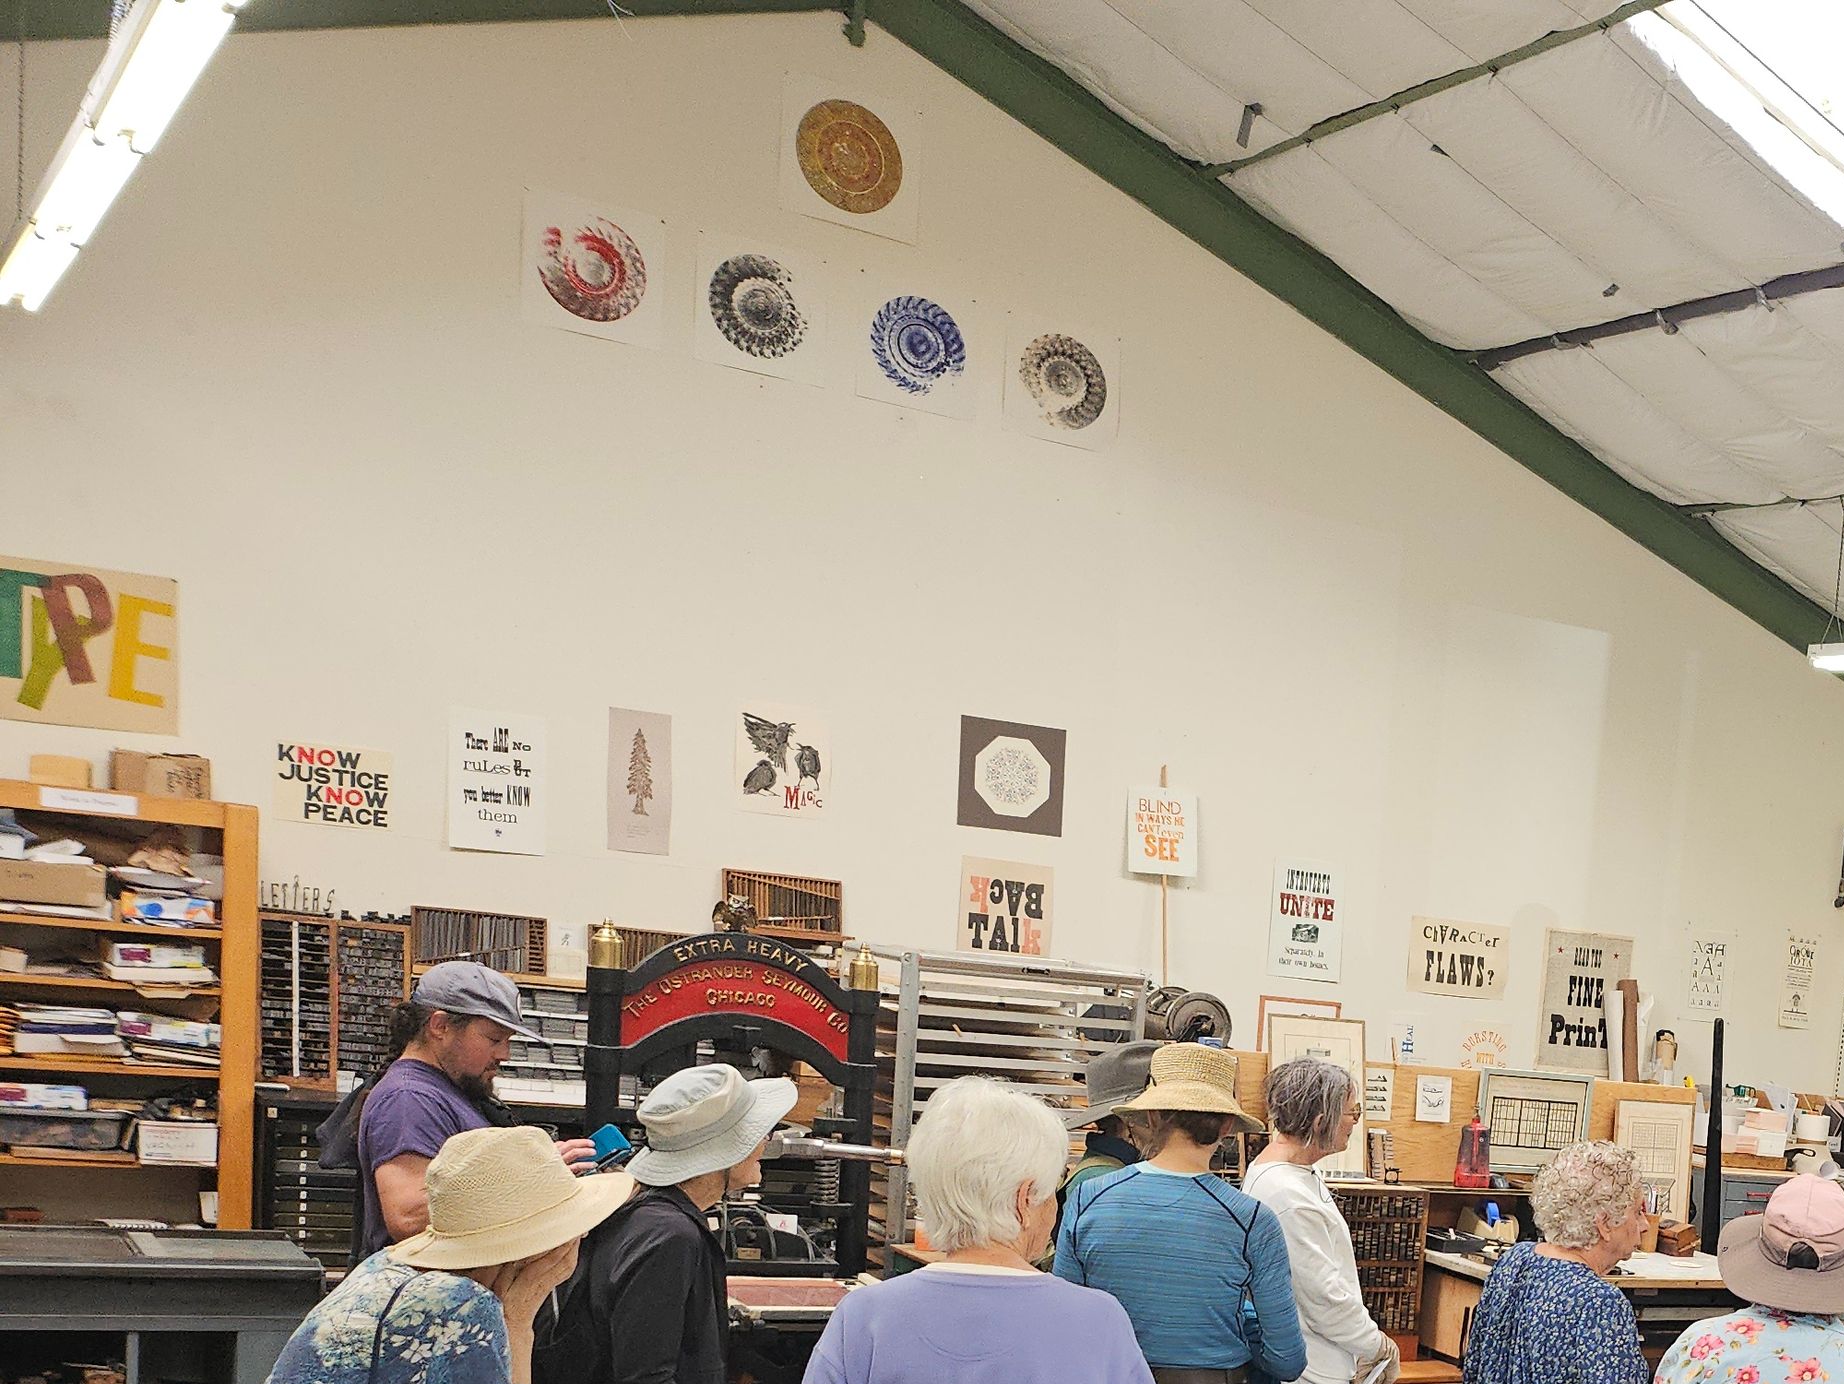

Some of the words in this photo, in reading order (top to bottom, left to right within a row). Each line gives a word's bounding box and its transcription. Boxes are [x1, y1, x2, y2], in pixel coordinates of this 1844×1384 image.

[278, 743, 360, 769] KNOW
[278, 763, 389, 791] JUSTICE
[306, 784, 388, 808] KNOW
[507, 785, 531, 807] KNOW
[1139, 798, 1181, 814] BLIND
[304, 802, 388, 827] PEACE
[478, 809, 518, 823] them
[1136, 813, 1146, 823] IN
[1147, 814, 1172, 825] WAYS
[1161, 828, 1184, 839] even
[1144, 834, 1179, 862] SEE
[1280, 892, 1335, 921] UNITE
[674, 938, 735, 962] EXTRA
[748, 936, 809, 973] HEAVY
[1425, 950, 1494, 987] FLAWS?
[623, 991, 657, 1018] THE
[659, 965, 753, 993] OSTRANDER
[762, 969, 827, 1013] SEYMOUR
[705, 988, 776, 1008] CHICAGO
[1567, 975, 1604, 1008] FINE
